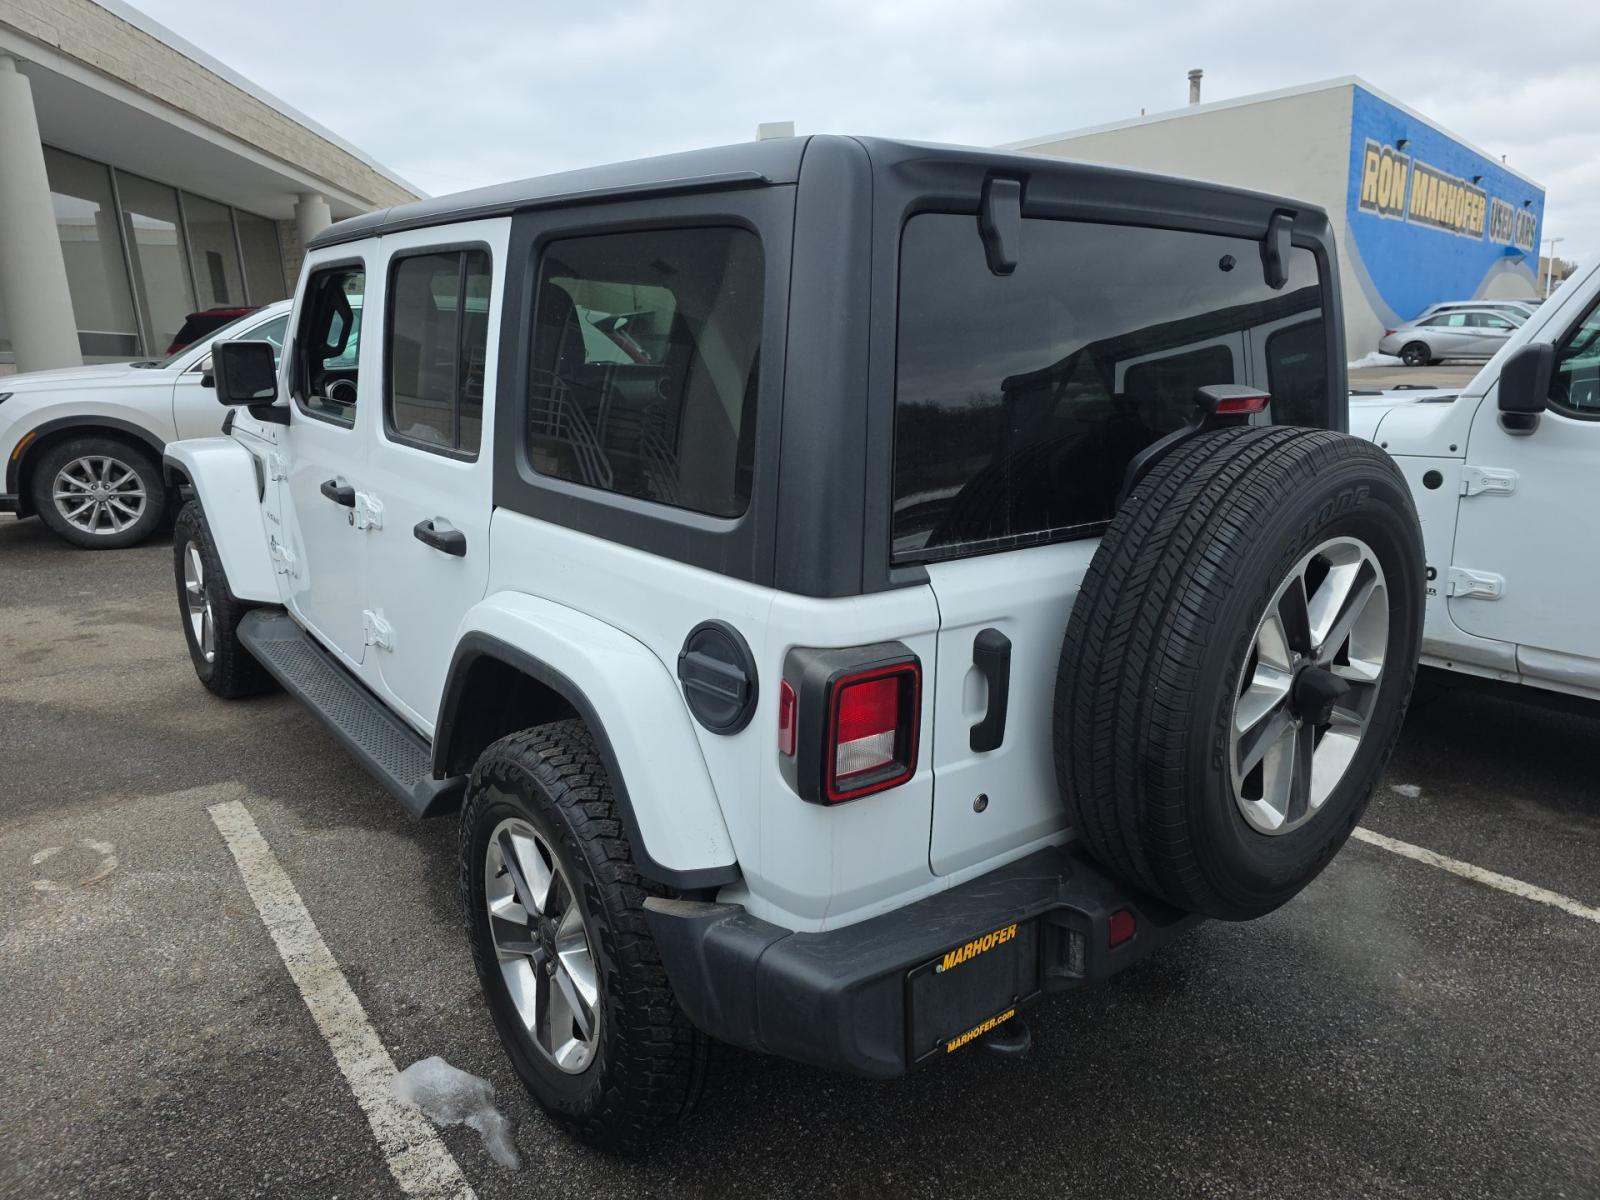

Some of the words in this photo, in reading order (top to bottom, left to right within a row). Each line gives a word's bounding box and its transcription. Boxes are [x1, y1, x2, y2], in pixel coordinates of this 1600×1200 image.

[1361, 143, 1409, 216] RON
[1409, 164, 1486, 237] MARHOFER
[1489, 198, 1513, 243] USED
[1514, 209, 1536, 251] CARS
[941, 923, 1017, 971] MARHOFER
[947, 1009, 1015, 1053] MARHOFER.com
